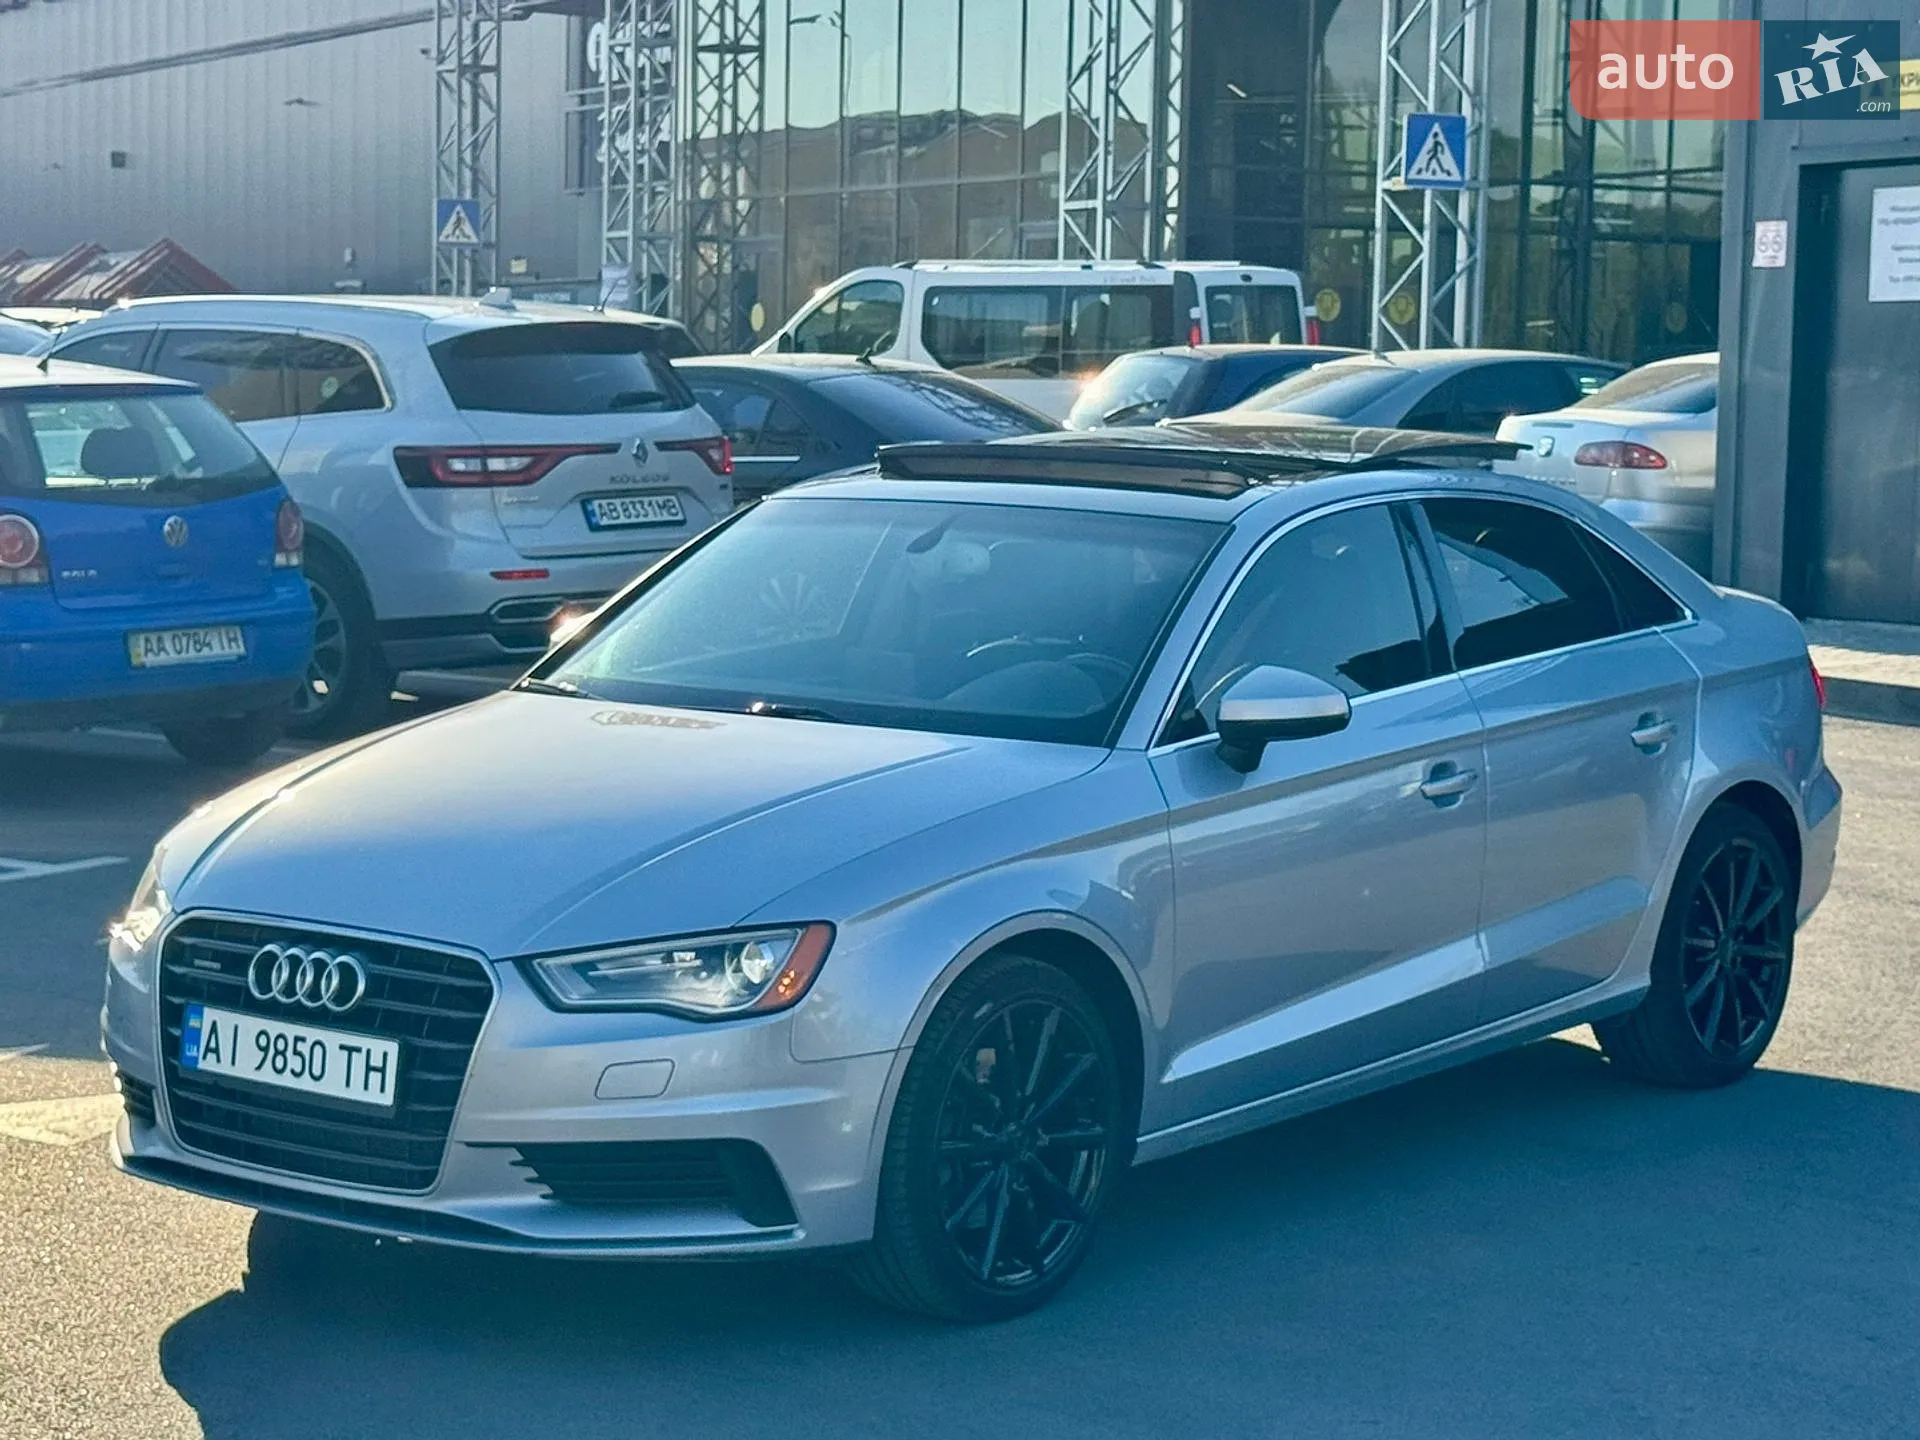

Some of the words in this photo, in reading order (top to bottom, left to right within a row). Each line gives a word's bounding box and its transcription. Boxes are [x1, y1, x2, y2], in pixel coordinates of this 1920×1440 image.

[143, 635, 170, 657] AA
[171, 631, 214, 655] 0784
[201, 1019, 239, 1067] AI
[254, 1029, 327, 1082] 9850
[338, 1043, 389, 1094] TH
